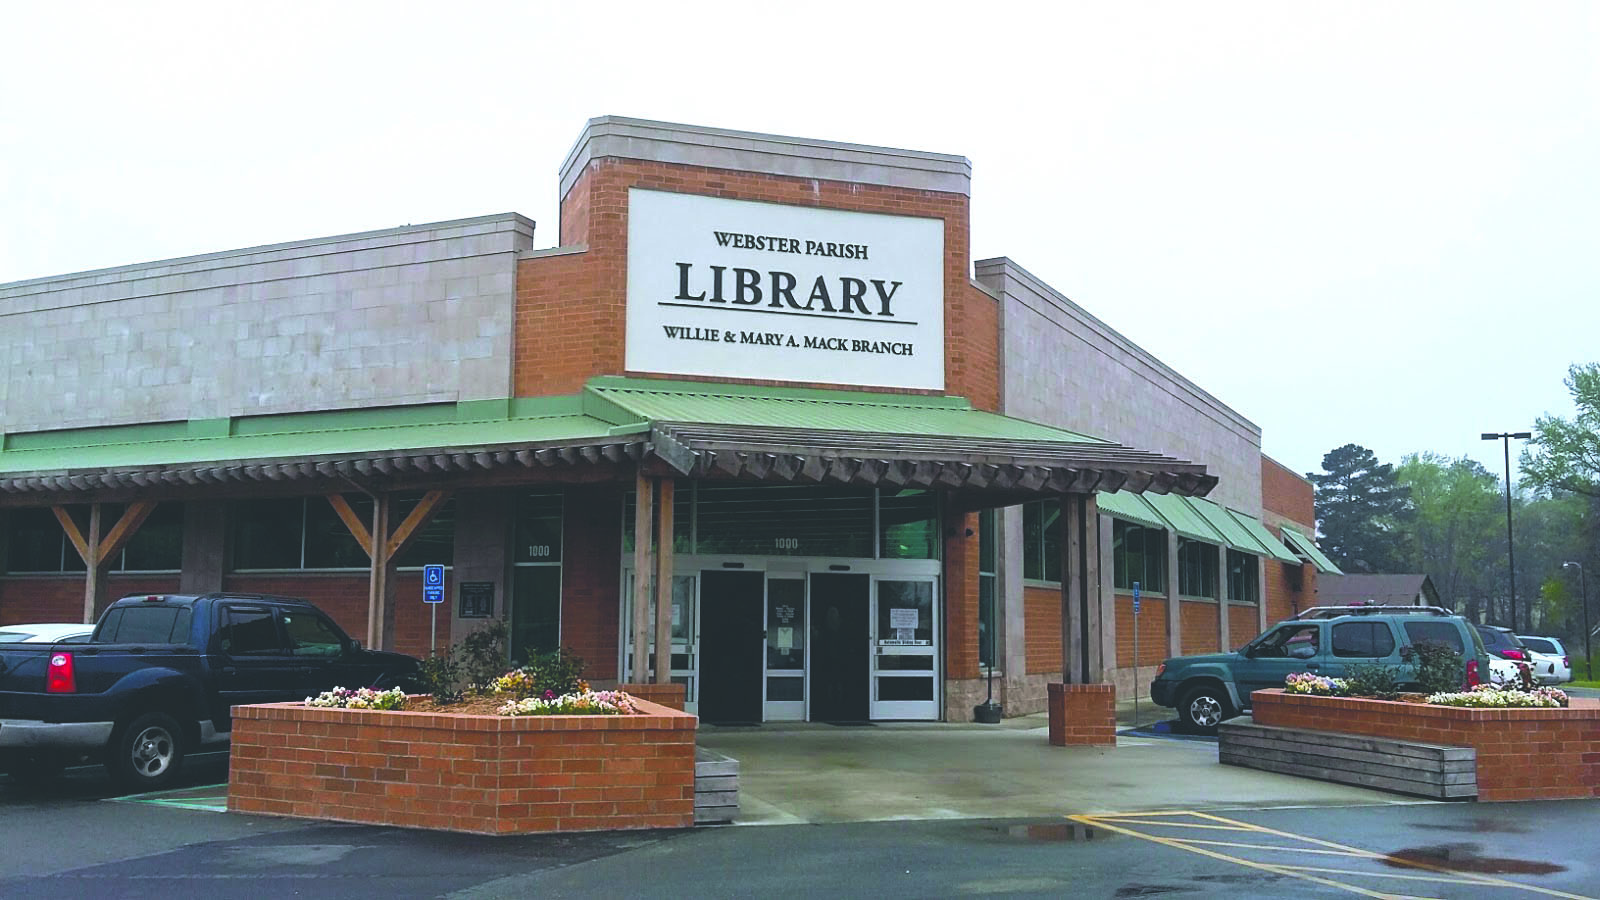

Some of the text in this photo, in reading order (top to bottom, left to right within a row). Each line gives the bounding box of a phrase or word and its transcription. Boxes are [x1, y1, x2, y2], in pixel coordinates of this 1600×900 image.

[713, 231, 869, 260] WEBSTER PARISH
[674, 262, 903, 317] LIBRARY
[662, 325, 914, 356] WILLIE & MARY A. MACK BRANCH
[529, 545, 550, 557] 1000
[775, 537, 798, 550] 1000
